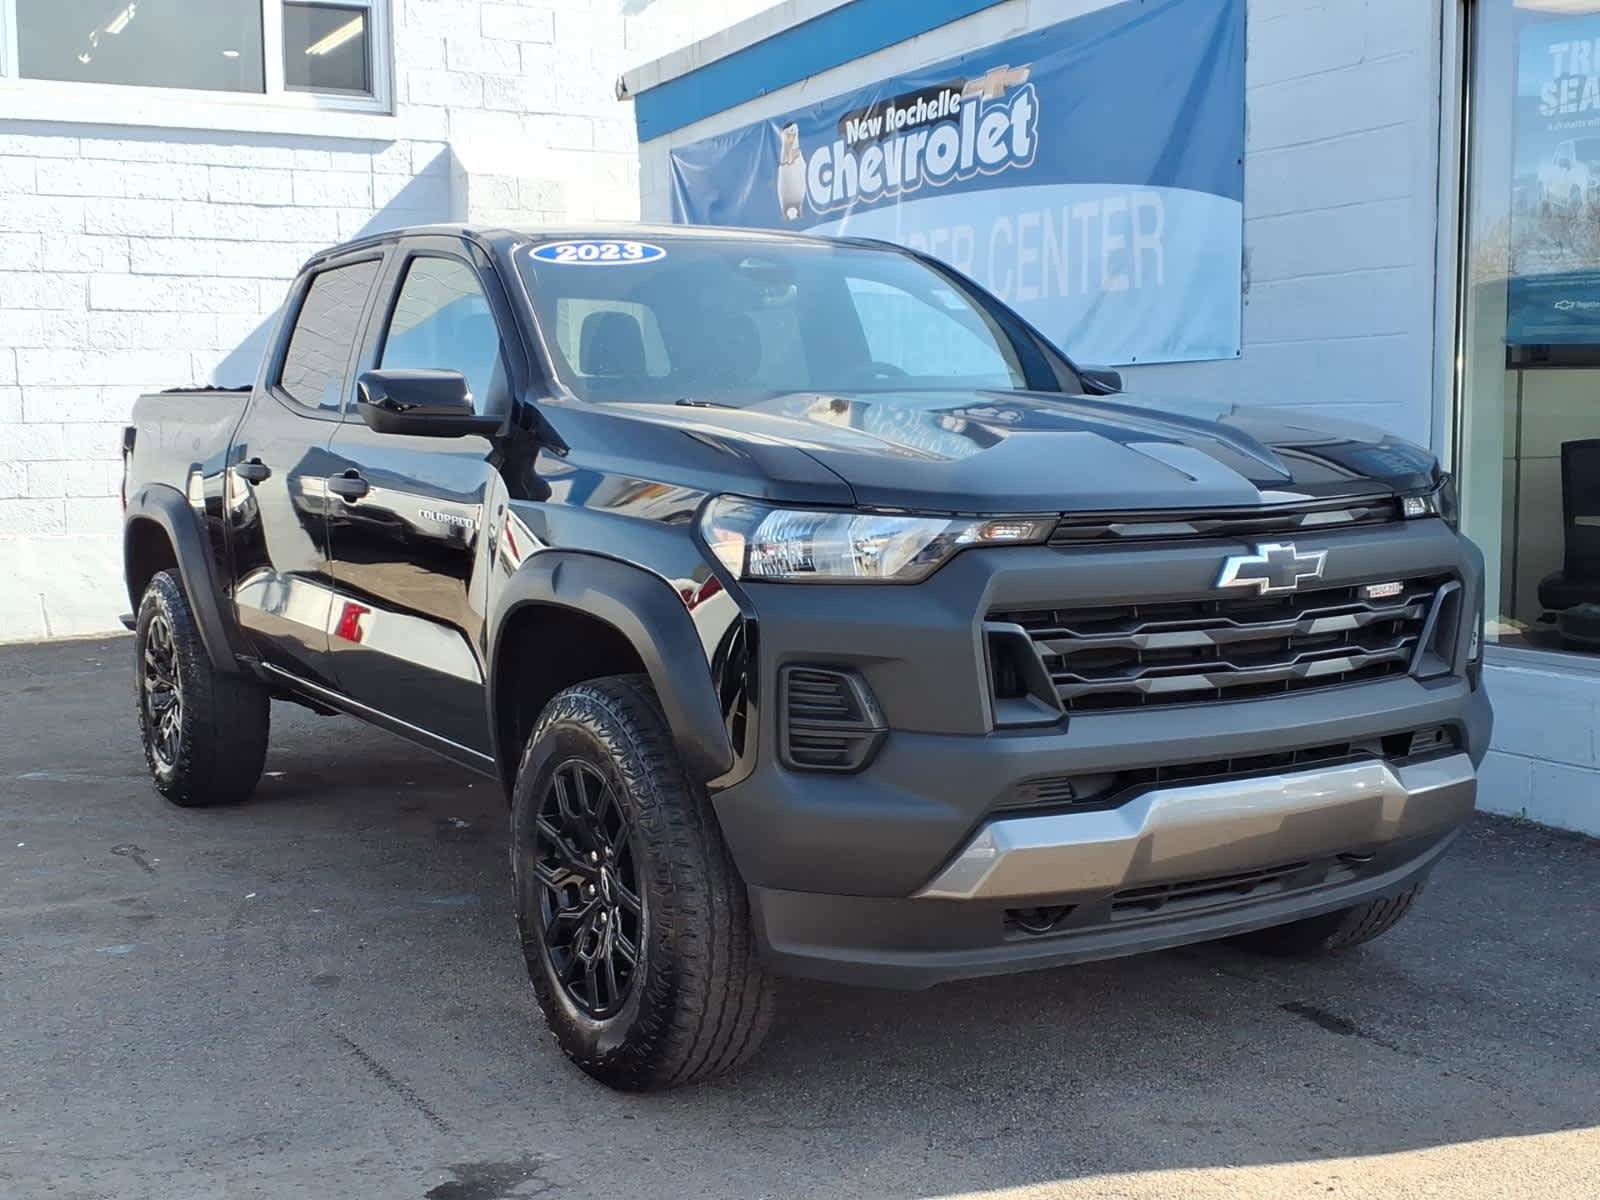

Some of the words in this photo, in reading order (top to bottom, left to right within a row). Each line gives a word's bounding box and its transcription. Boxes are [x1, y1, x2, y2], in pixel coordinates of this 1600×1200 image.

[845, 116, 884, 145] New
[885, 88, 961, 133] Rochelle
[554, 243, 644, 262] 2023
[986, 190, 1166, 302] CENTER
[418, 508, 474, 529] COLORADO
